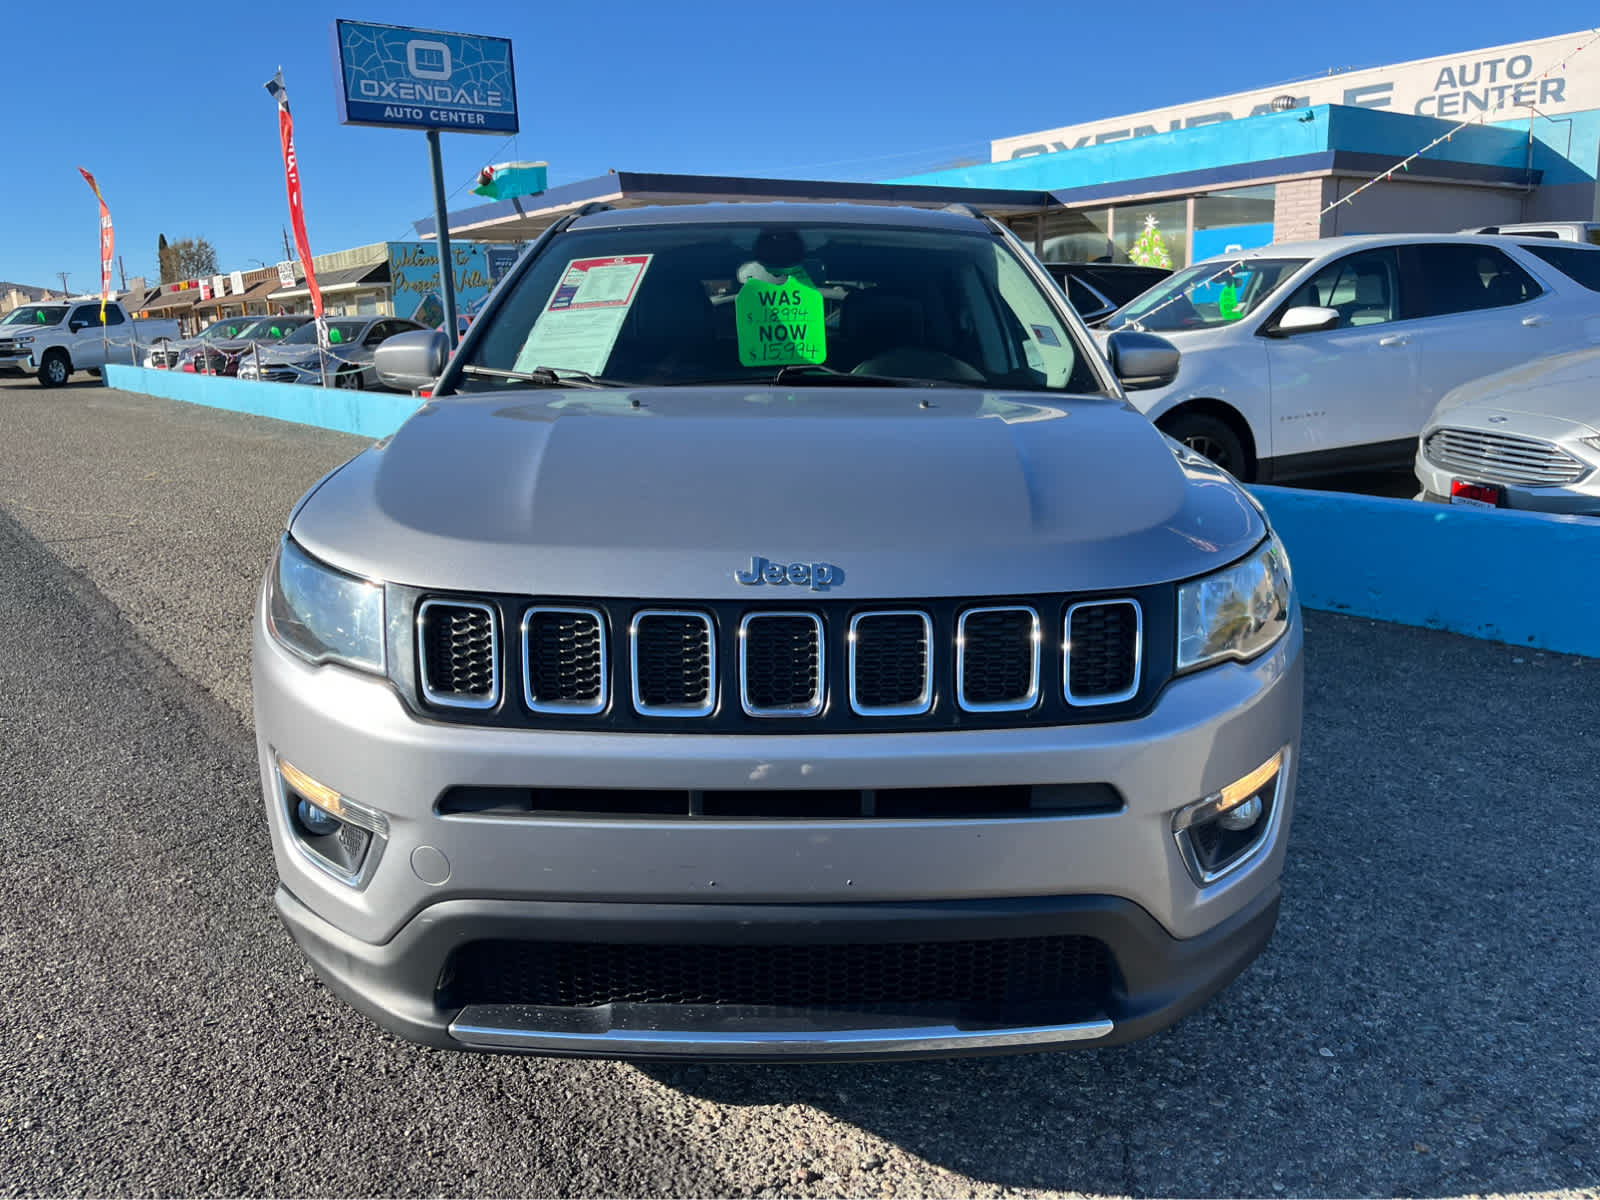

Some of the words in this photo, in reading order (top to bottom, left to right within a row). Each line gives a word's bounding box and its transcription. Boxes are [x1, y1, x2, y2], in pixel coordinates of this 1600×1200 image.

[1434, 54, 1533, 92] AUTO
[360, 79, 503, 107] OXENDALE
[1414, 77, 1566, 119] CENTER
[384, 106, 423, 120] AUTO
[430, 110, 486, 125] CENTER
[389, 246, 440, 272] Welcom
[392, 271, 441, 296] Prescot
[758, 290, 801, 307] WAS
[759, 324, 807, 341] NOW
[734, 556, 833, 592] Jeep
